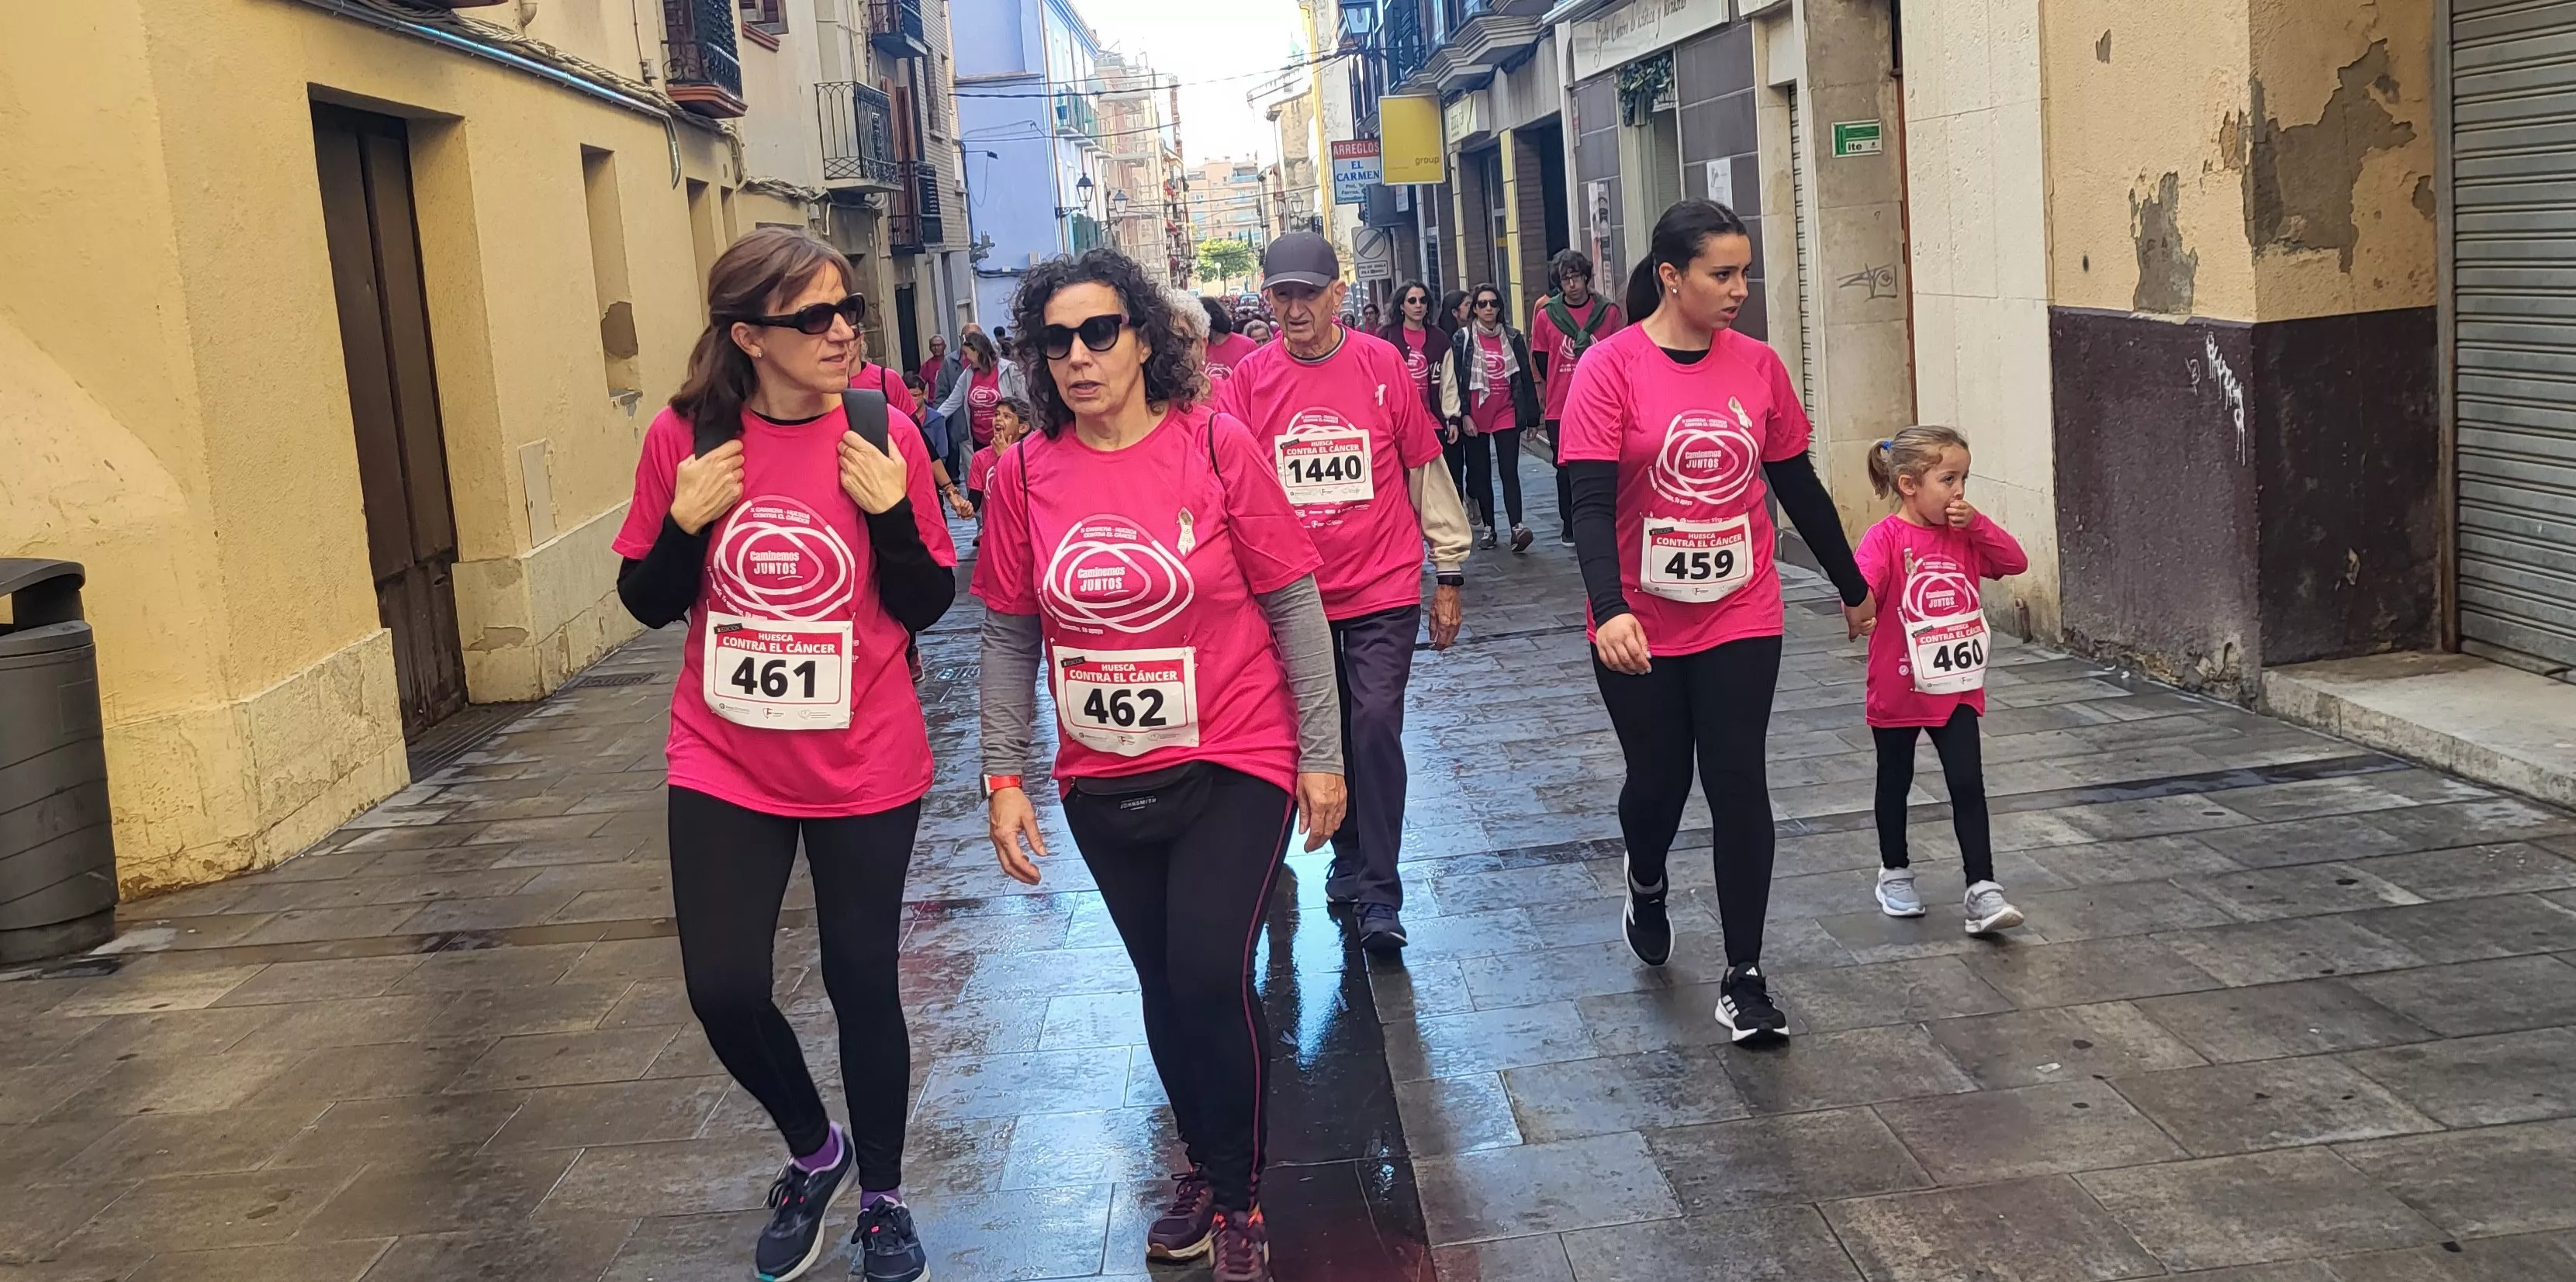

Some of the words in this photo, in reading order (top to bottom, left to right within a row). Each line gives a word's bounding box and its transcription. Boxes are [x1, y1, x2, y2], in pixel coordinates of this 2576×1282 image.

[1333, 141, 1379, 156] ARREGLOS
[1351, 161, 1364, 169] EL
[1415, 157, 1440, 166] group
[1336, 170, 1380, 182] CARMEN
[1287, 447, 1318, 456] CONTRA
[1329, 444, 1360, 453] CÁNCER
[1288, 454, 1362, 483] 1440
[1686, 458, 1719, 468] JUNTOS
[1657, 537, 1695, 548] CONTRA
[1710, 533, 1742, 547] CÁNCER
[750, 550, 800, 561] Caminemos
[753, 562, 797, 575] JUNTOS
[1665, 549, 1734, 580] 459
[1080, 577, 1122, 592] JUNTOS
[759, 633, 794, 642] HUESCA
[1920, 633, 1955, 644] CONTRA
[723, 636, 766, 651] CONTRA
[769, 642, 783, 653] EL
[786, 641, 835, 654] CÁNCER
[1933, 638, 1983, 672] 460
[731, 656, 816, 698] 461
[1070, 669, 1113, 682] CONTRA
[1114, 672, 1127, 682] EL
[1129, 670, 1177, 682] CÁNCER
[1084, 688, 1166, 727] 462
